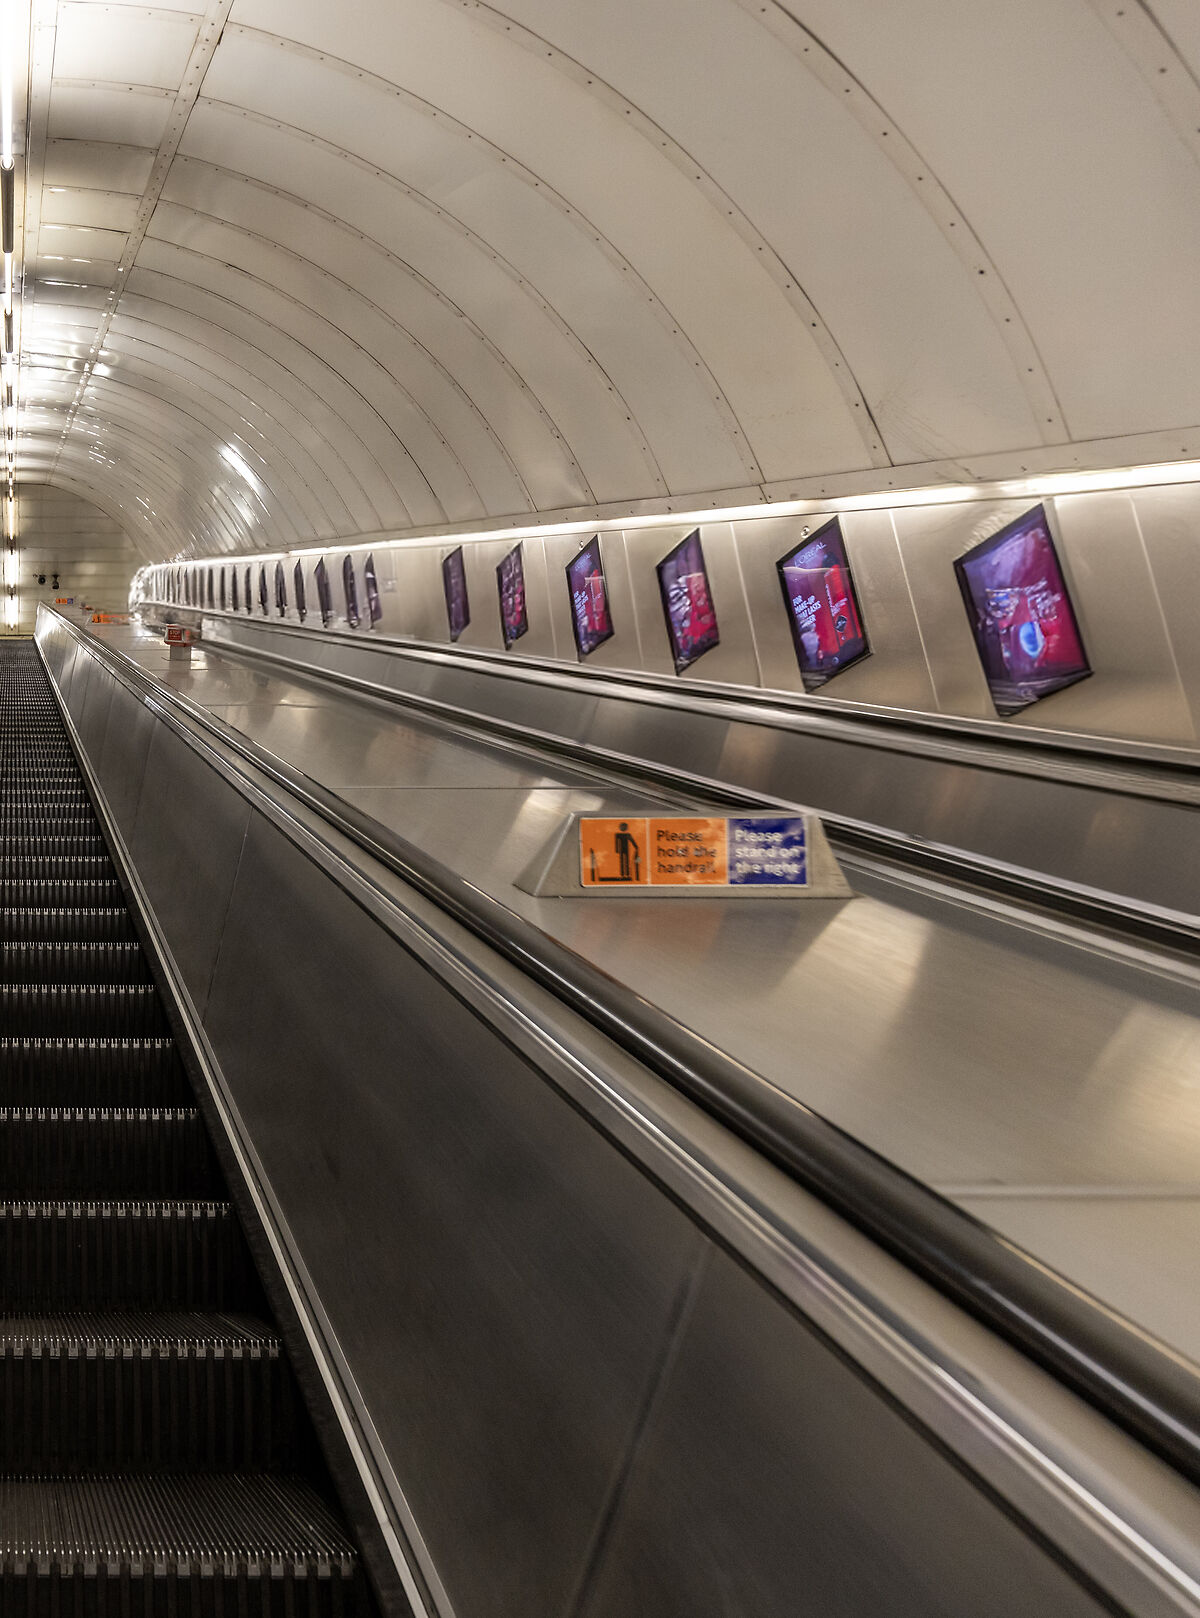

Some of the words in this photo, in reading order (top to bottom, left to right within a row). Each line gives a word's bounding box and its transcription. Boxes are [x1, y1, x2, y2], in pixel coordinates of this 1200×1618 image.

[656, 830, 703, 842] Please
[735, 829, 782, 842] Please
[657, 846, 688, 858] hold
[693, 846, 717, 858] the
[735, 845, 777, 859] stand
[778, 847, 800, 859] on
[657, 862, 716, 874] handrail
[735, 861, 762, 874] the
